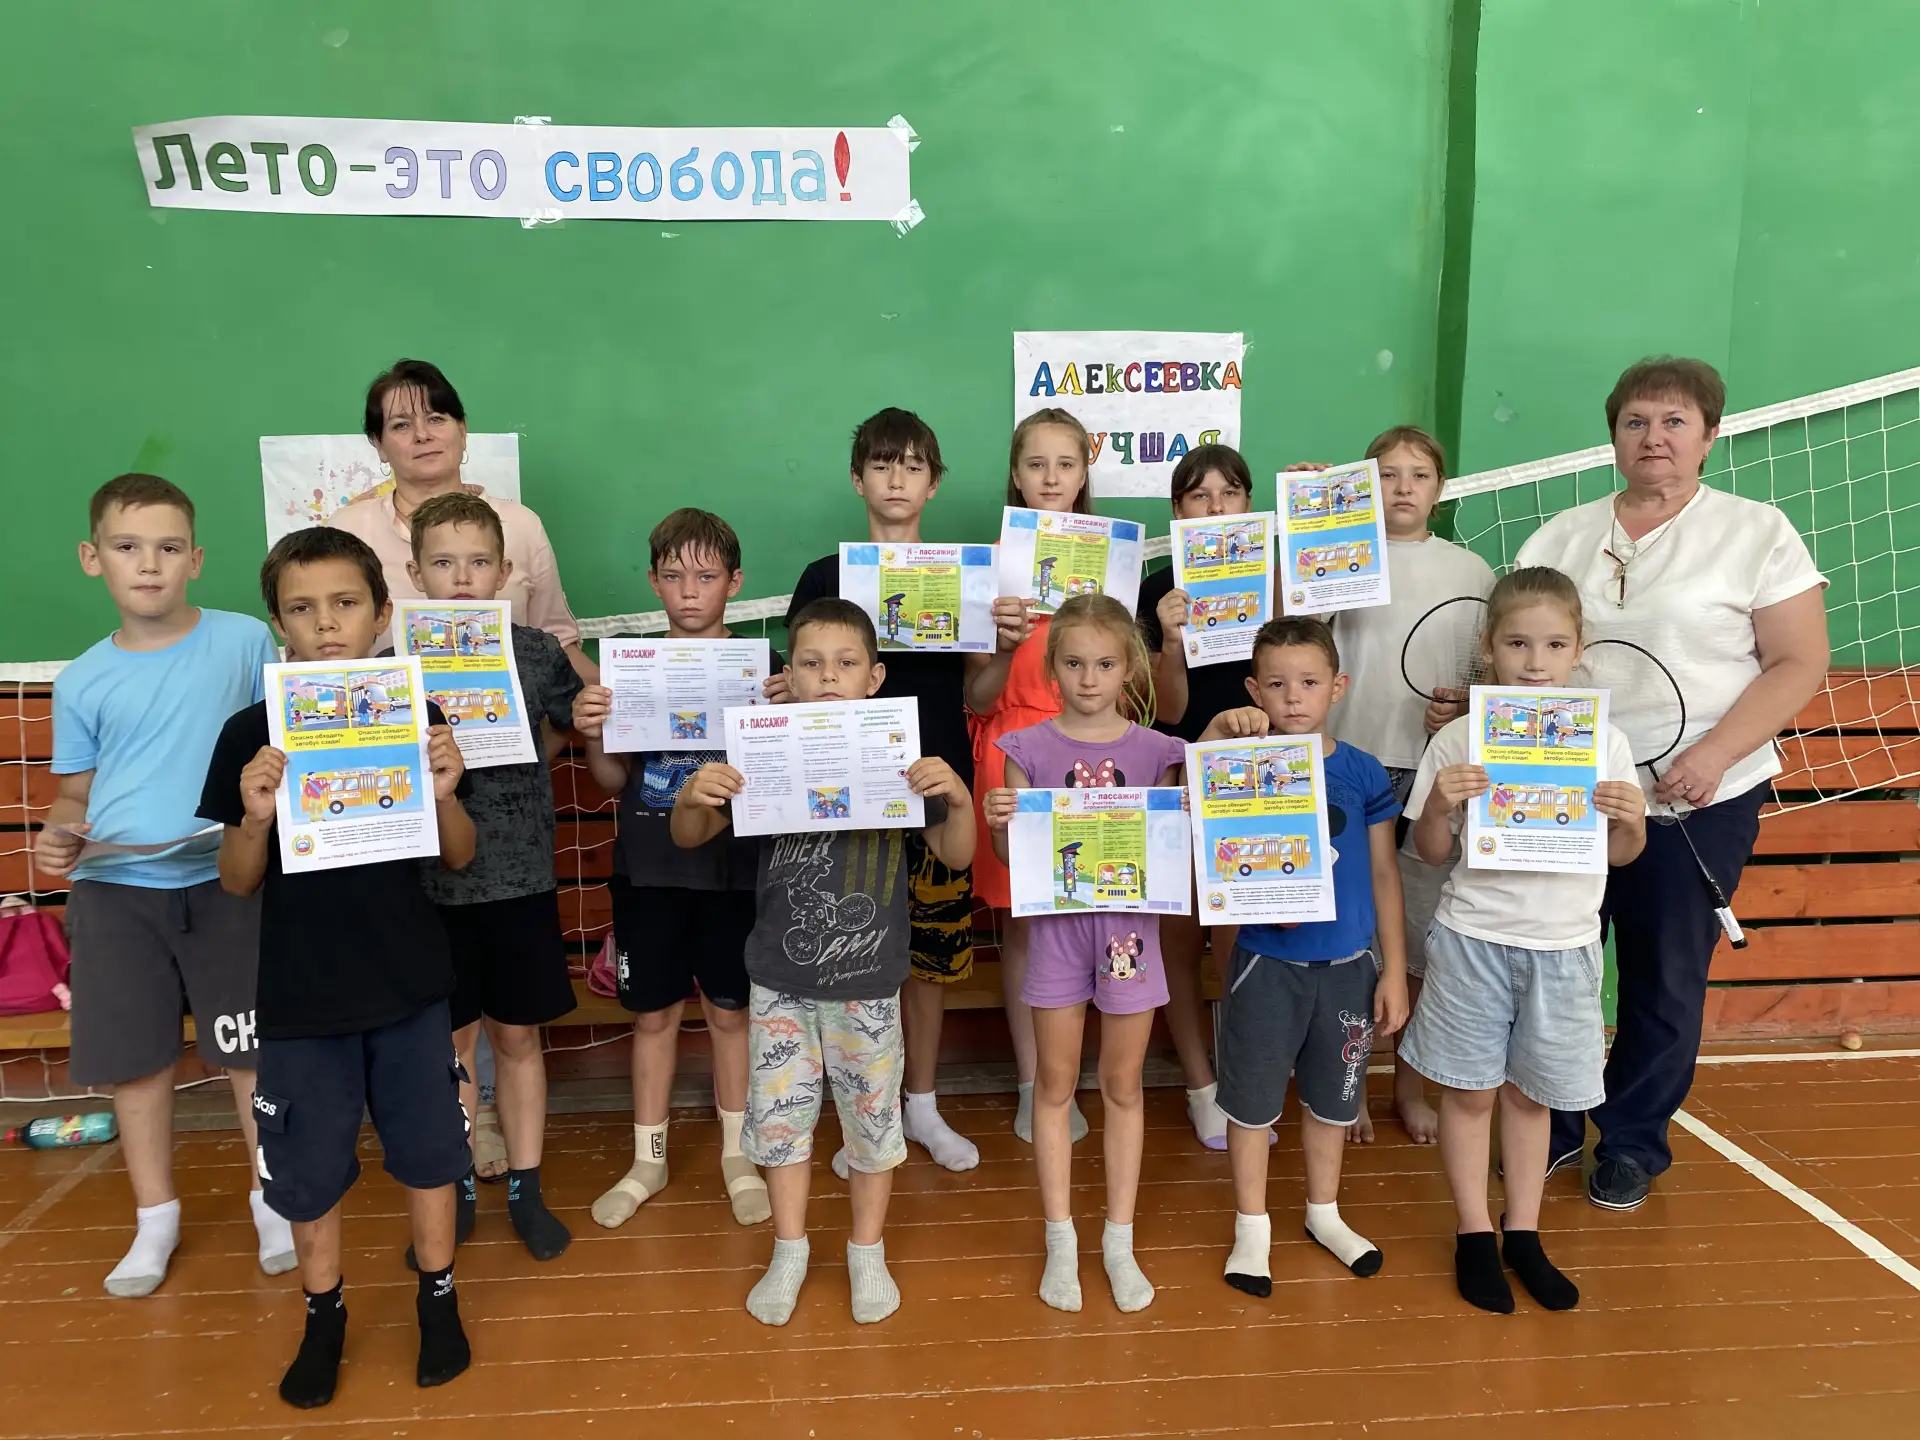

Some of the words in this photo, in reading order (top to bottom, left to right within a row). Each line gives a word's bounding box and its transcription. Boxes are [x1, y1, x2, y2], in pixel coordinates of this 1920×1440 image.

[545, 131, 852, 205] свобода!
[1087, 430, 1221, 464] УЧШАЯ
[919, 548, 957, 556] пассажир!
[612, 649, 617, 658] Я
[621, 649, 656, 659] ПАССАЖИР
[739, 719, 745, 729] Я
[750, 716, 789, 729] ПАССАЖИР
[1084, 792, 1090, 801] Я
[1098, 791, 1142, 801] пассажир!
[816, 926, 889, 967] BMX
